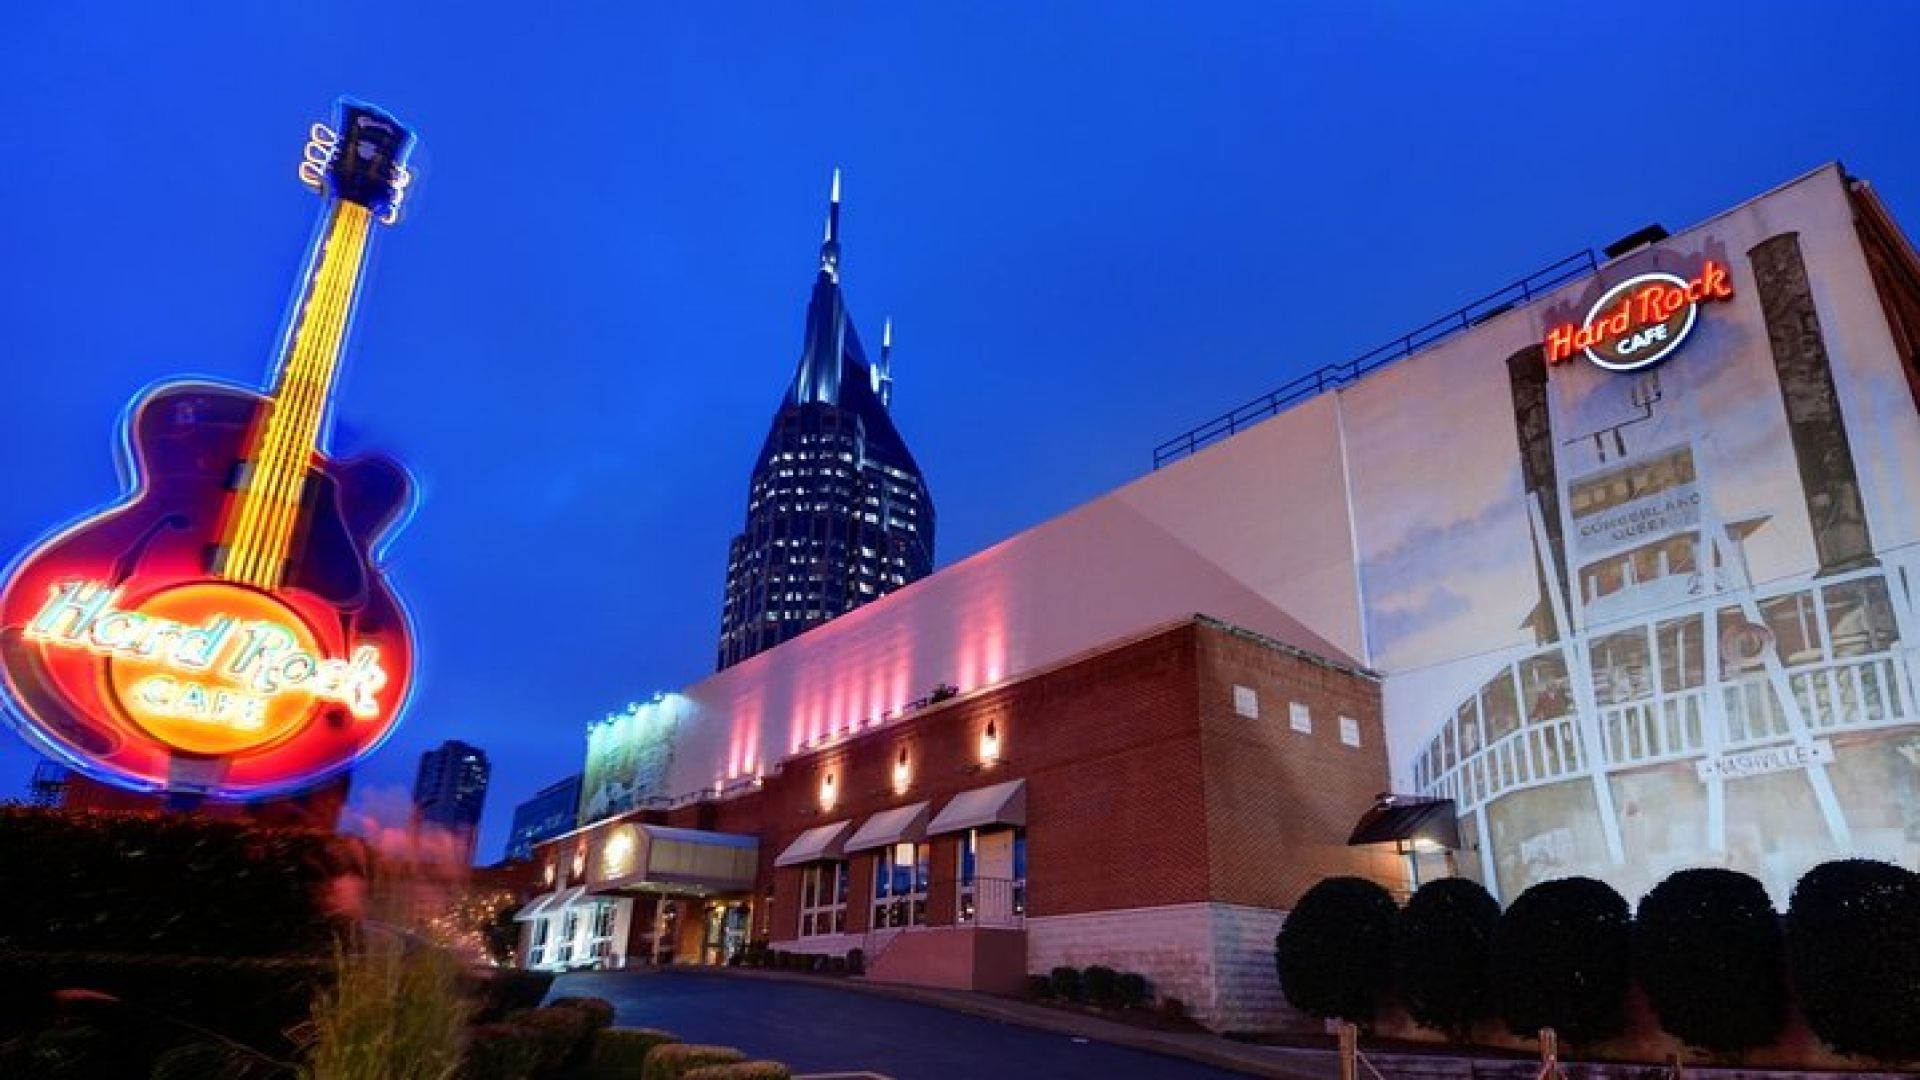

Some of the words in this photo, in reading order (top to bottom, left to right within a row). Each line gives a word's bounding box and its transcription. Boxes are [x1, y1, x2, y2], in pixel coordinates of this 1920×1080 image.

[1547, 299, 1631, 362] Hard
[1637, 260, 1732, 322] Rock
[1616, 323, 1668, 355] CAFE
[24, 580, 241, 668] Hard
[228, 617, 386, 717] Rock
[139, 676, 267, 729] CAFE
[1714, 747, 1809, 775] NASHVILLE
